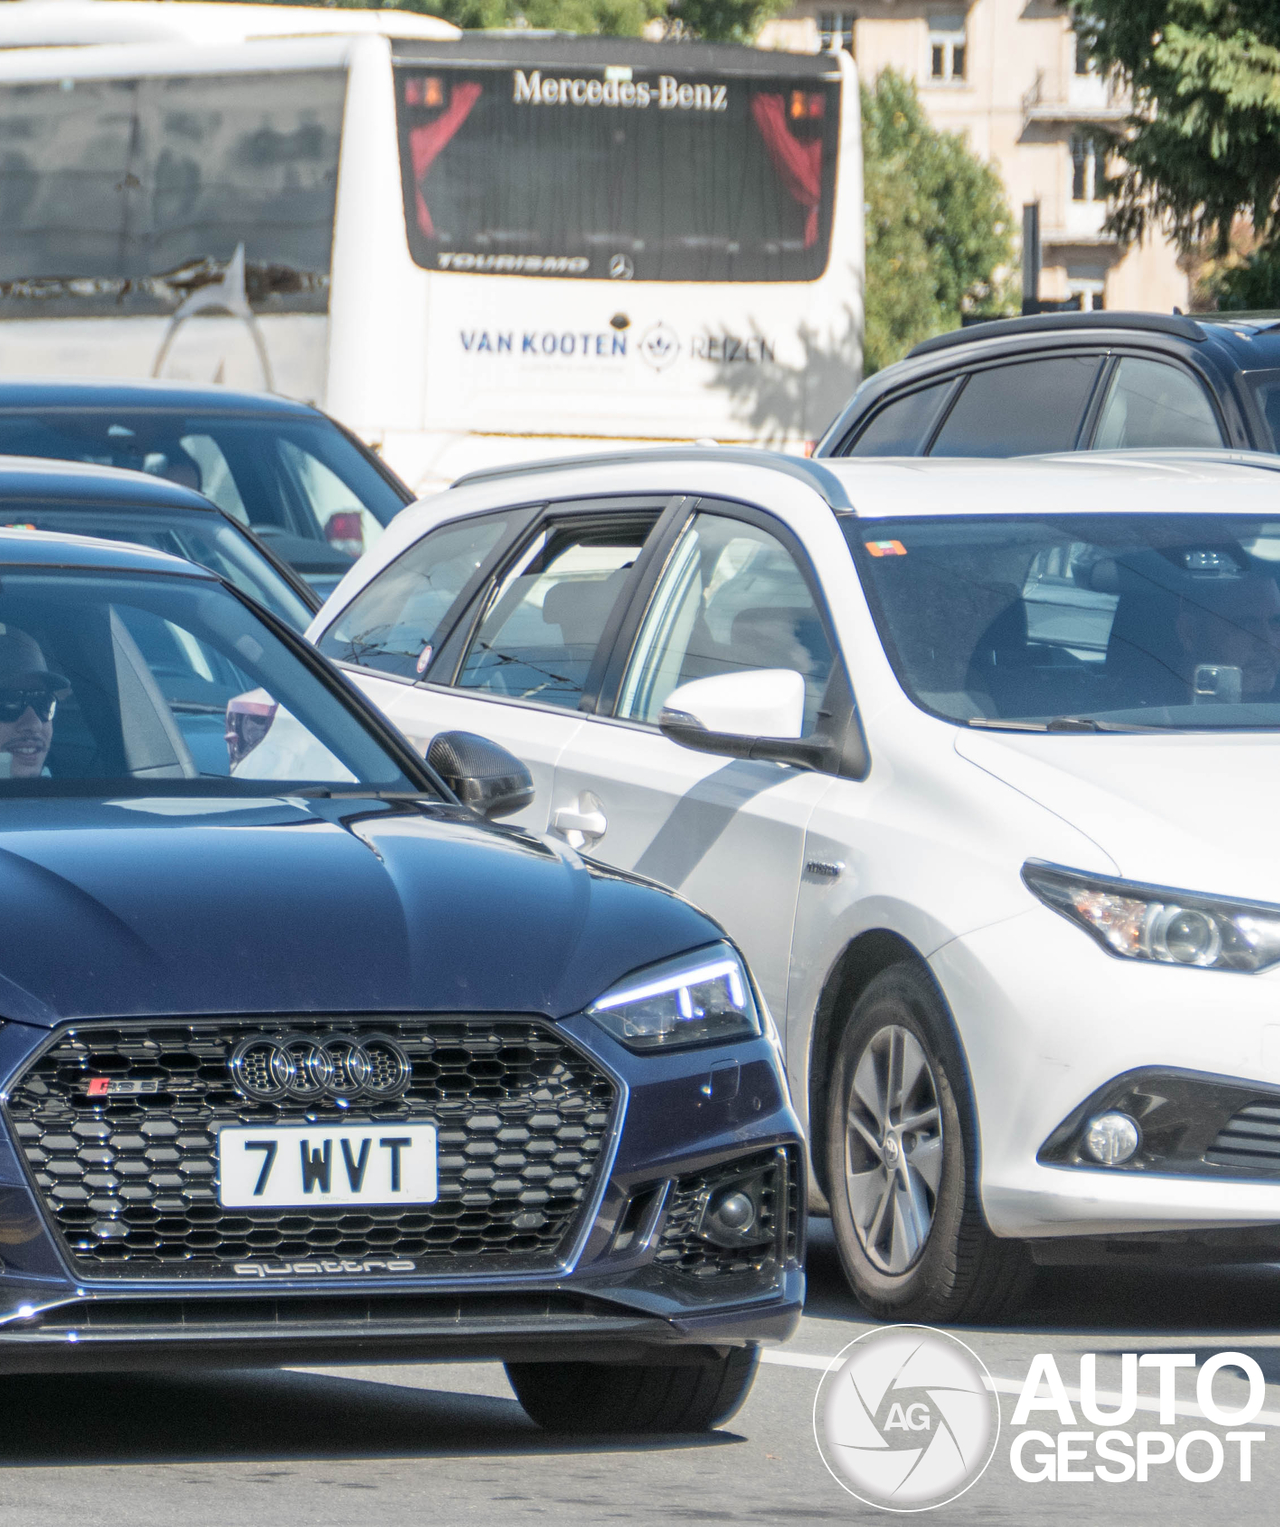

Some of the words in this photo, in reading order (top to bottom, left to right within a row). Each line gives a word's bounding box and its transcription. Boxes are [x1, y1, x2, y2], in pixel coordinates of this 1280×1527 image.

[514, 69, 728, 111] Mercedes-Benz
[437, 253, 590, 273] TOURISMO
[460, 331, 513, 352] VAN
[522, 332, 628, 356] KOOTEN
[690, 335, 776, 362] REIZEN
[245, 1140, 278, 1196] 7
[300, 1137, 412, 1194] WVT
[233, 1260, 416, 1278] quattro
